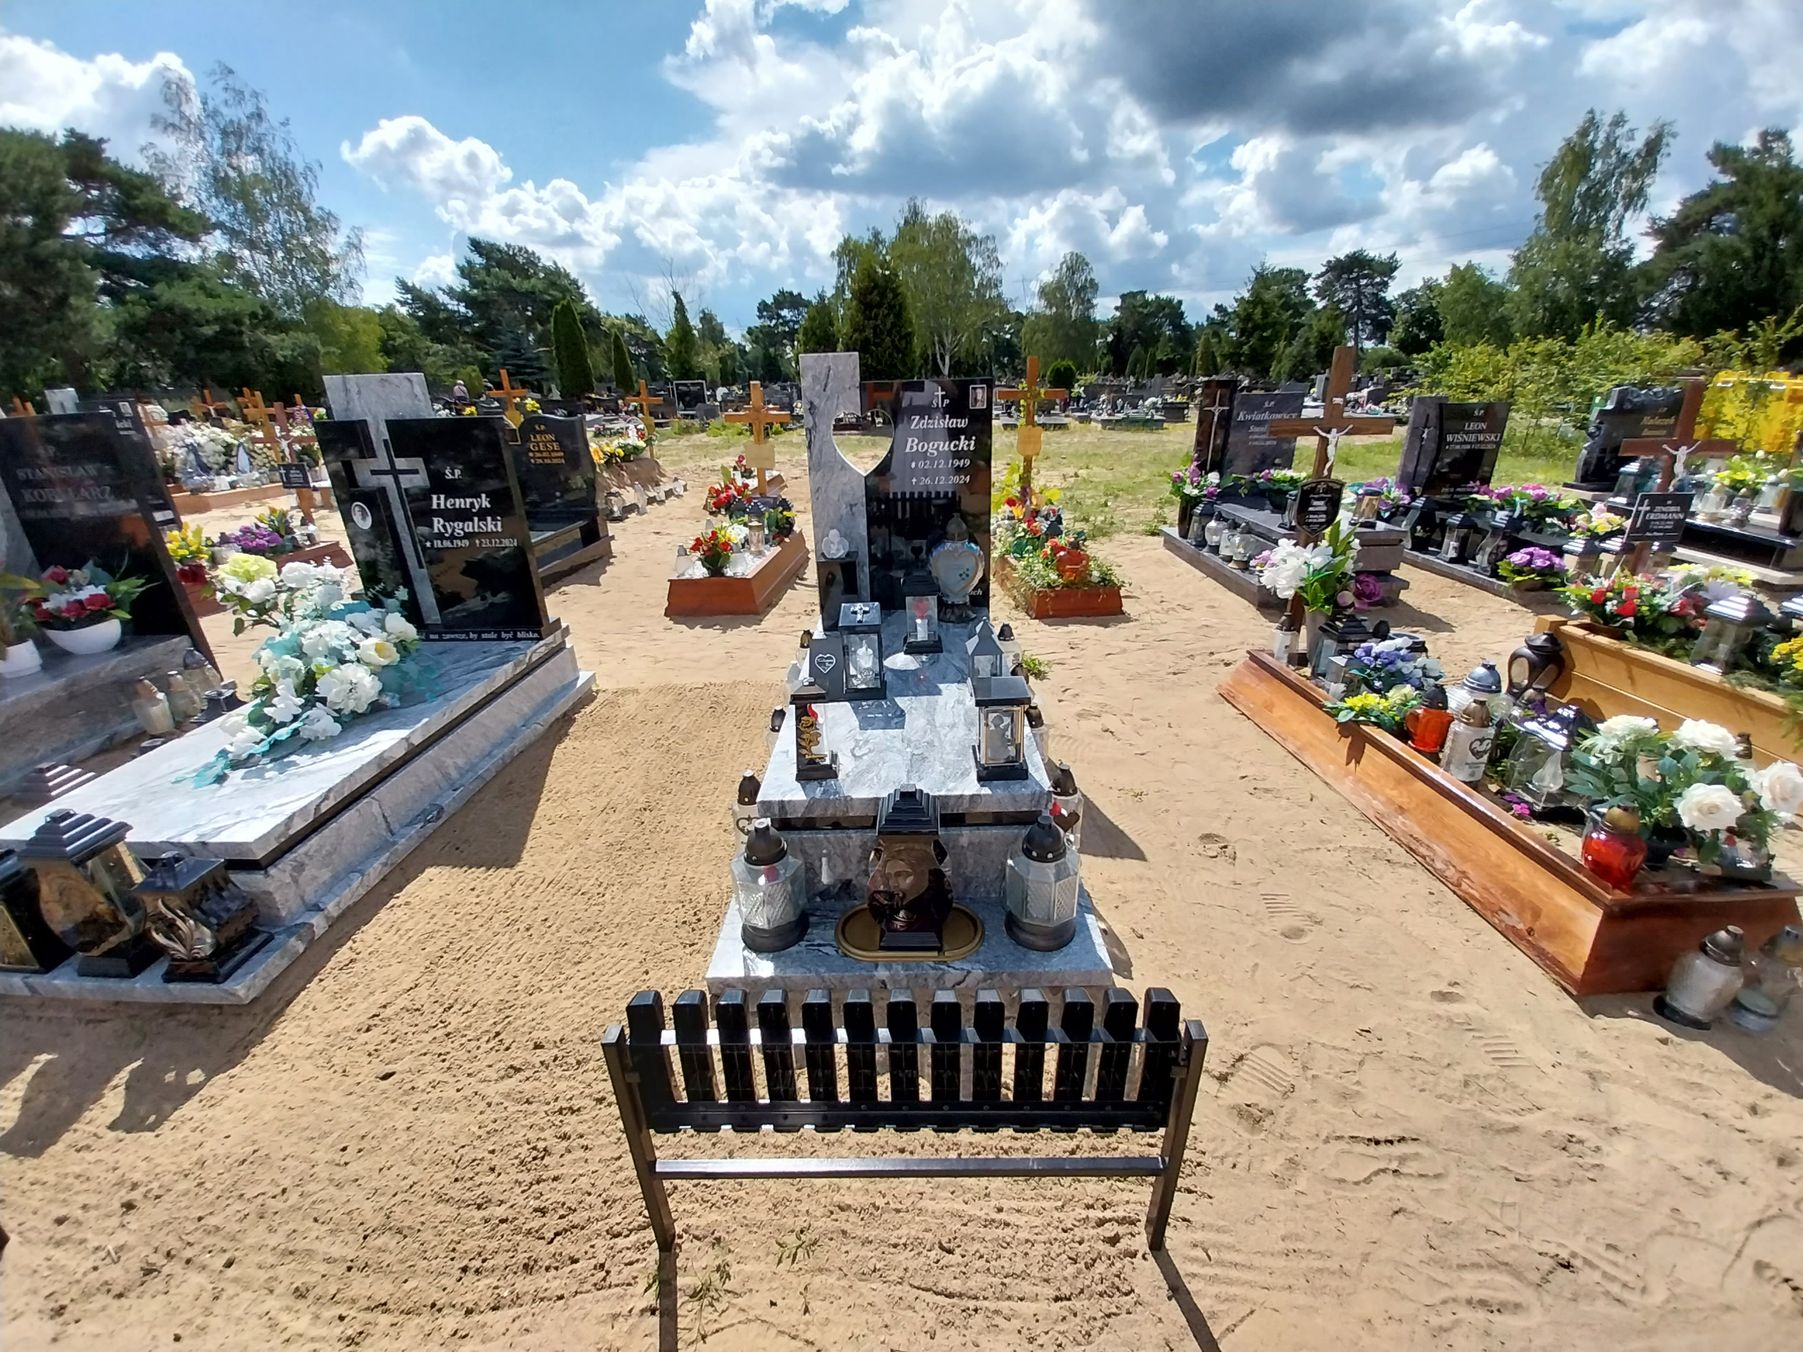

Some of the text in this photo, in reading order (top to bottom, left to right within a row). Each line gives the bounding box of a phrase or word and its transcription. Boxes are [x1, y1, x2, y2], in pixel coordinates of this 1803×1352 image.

[910, 414, 969, 430] Zdzisław
[1464, 422, 1488, 431] LEON
[530, 433, 556, 442] LEON
[1446, 431, 1501, 442] WIŚNIEWSKI
[904, 435, 977, 458] Bogucki
[918, 459, 970, 469] 02.12.1949
[444, 466, 463, 480] Ś.P.
[919, 475, 970, 485] 26.12.2024
[430, 493, 492, 513] Henryk
[431, 516, 504, 537] Rygalski
[469, 631, 478, 641] by
[501, 631, 514, 640] być
